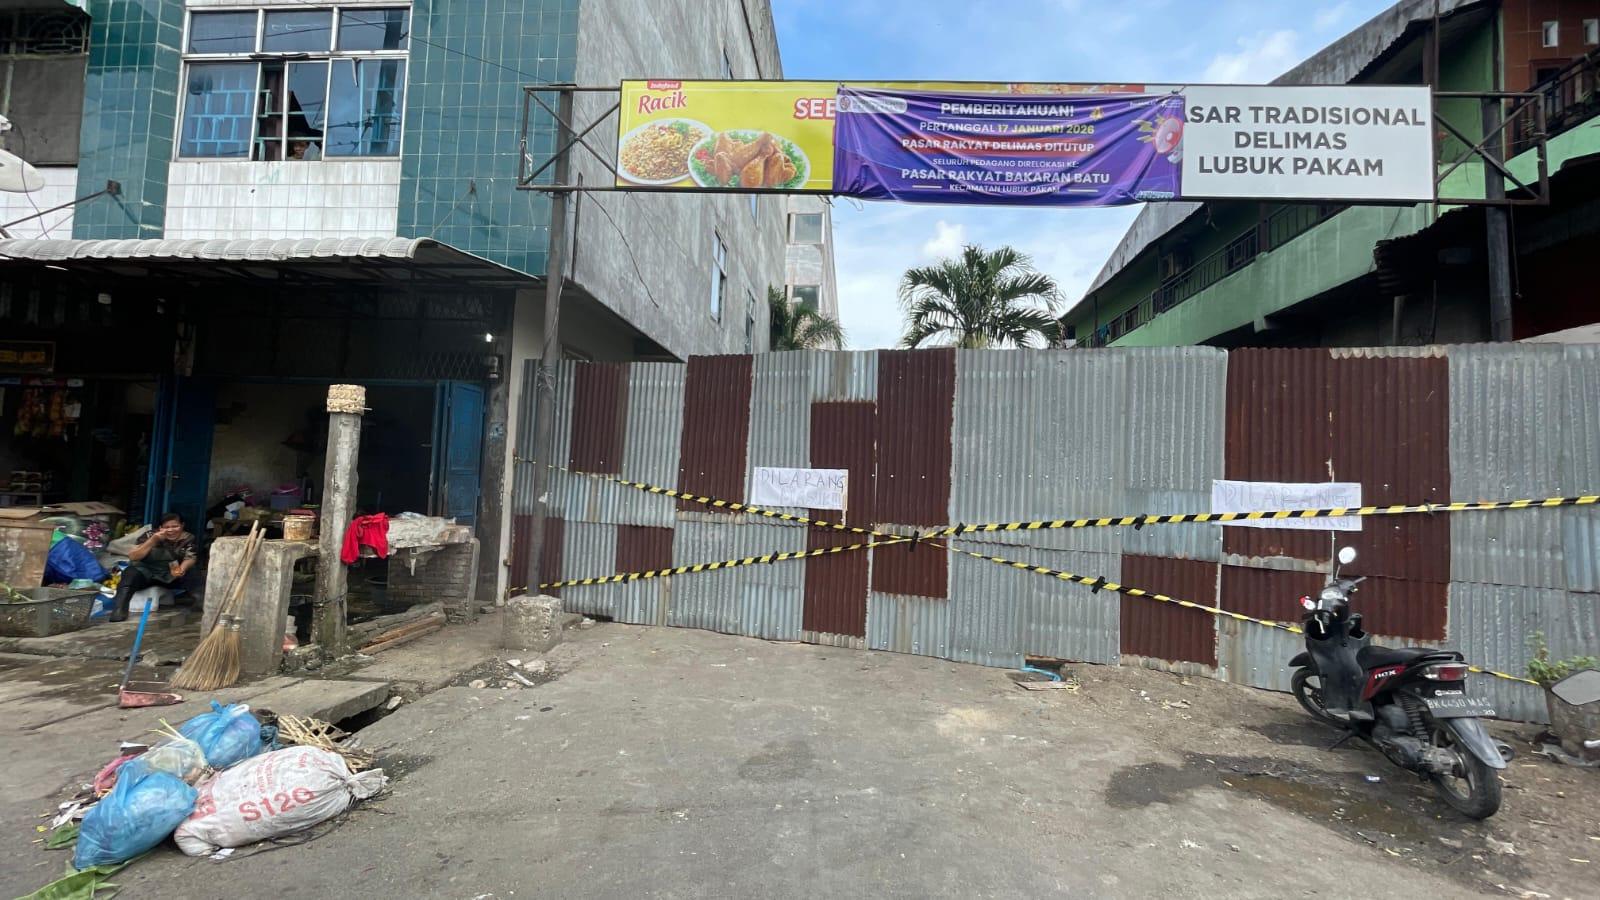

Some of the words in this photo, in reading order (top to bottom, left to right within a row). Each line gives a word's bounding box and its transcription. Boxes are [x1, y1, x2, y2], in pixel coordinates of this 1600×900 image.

[638, 91, 687, 114] Racik
[940, 102, 1074, 117] PEMBERITAHUAN!
[1248, 106, 1426, 126] TRADISIONAL
[919, 121, 995, 133] PERTANGGAL
[998, 124, 1008, 134] 17
[1011, 124, 1064, 134] JANUARI
[1066, 124, 1095, 135] 2026
[902, 139, 941, 149] PASAR
[943, 140, 989, 150] RAKYAT
[992, 141, 1042, 151] DELIMAS
[1044, 142, 1095, 153] DITUTUP
[1234, 131, 1348, 150] DELIMAS
[933, 158, 969, 166] SELURUH
[970, 159, 1016, 167] PEDAGANG
[1017, 160, 1065, 168] DIRELOKASI
[1199, 156, 1284, 175] LUBUK
[1292, 157, 1384, 177] PAKAM
[901, 168, 945, 180] PASAR
[948, 170, 1002, 182] RAKYAT
[1004, 171, 1071, 183] BAKARAN
[1073, 173, 1110, 184] BATU
[949, 183, 1001, 193] KECAMATAN
[1002, 185, 1028, 193] LUBUK
[761, 469, 845, 493] DILARANG
